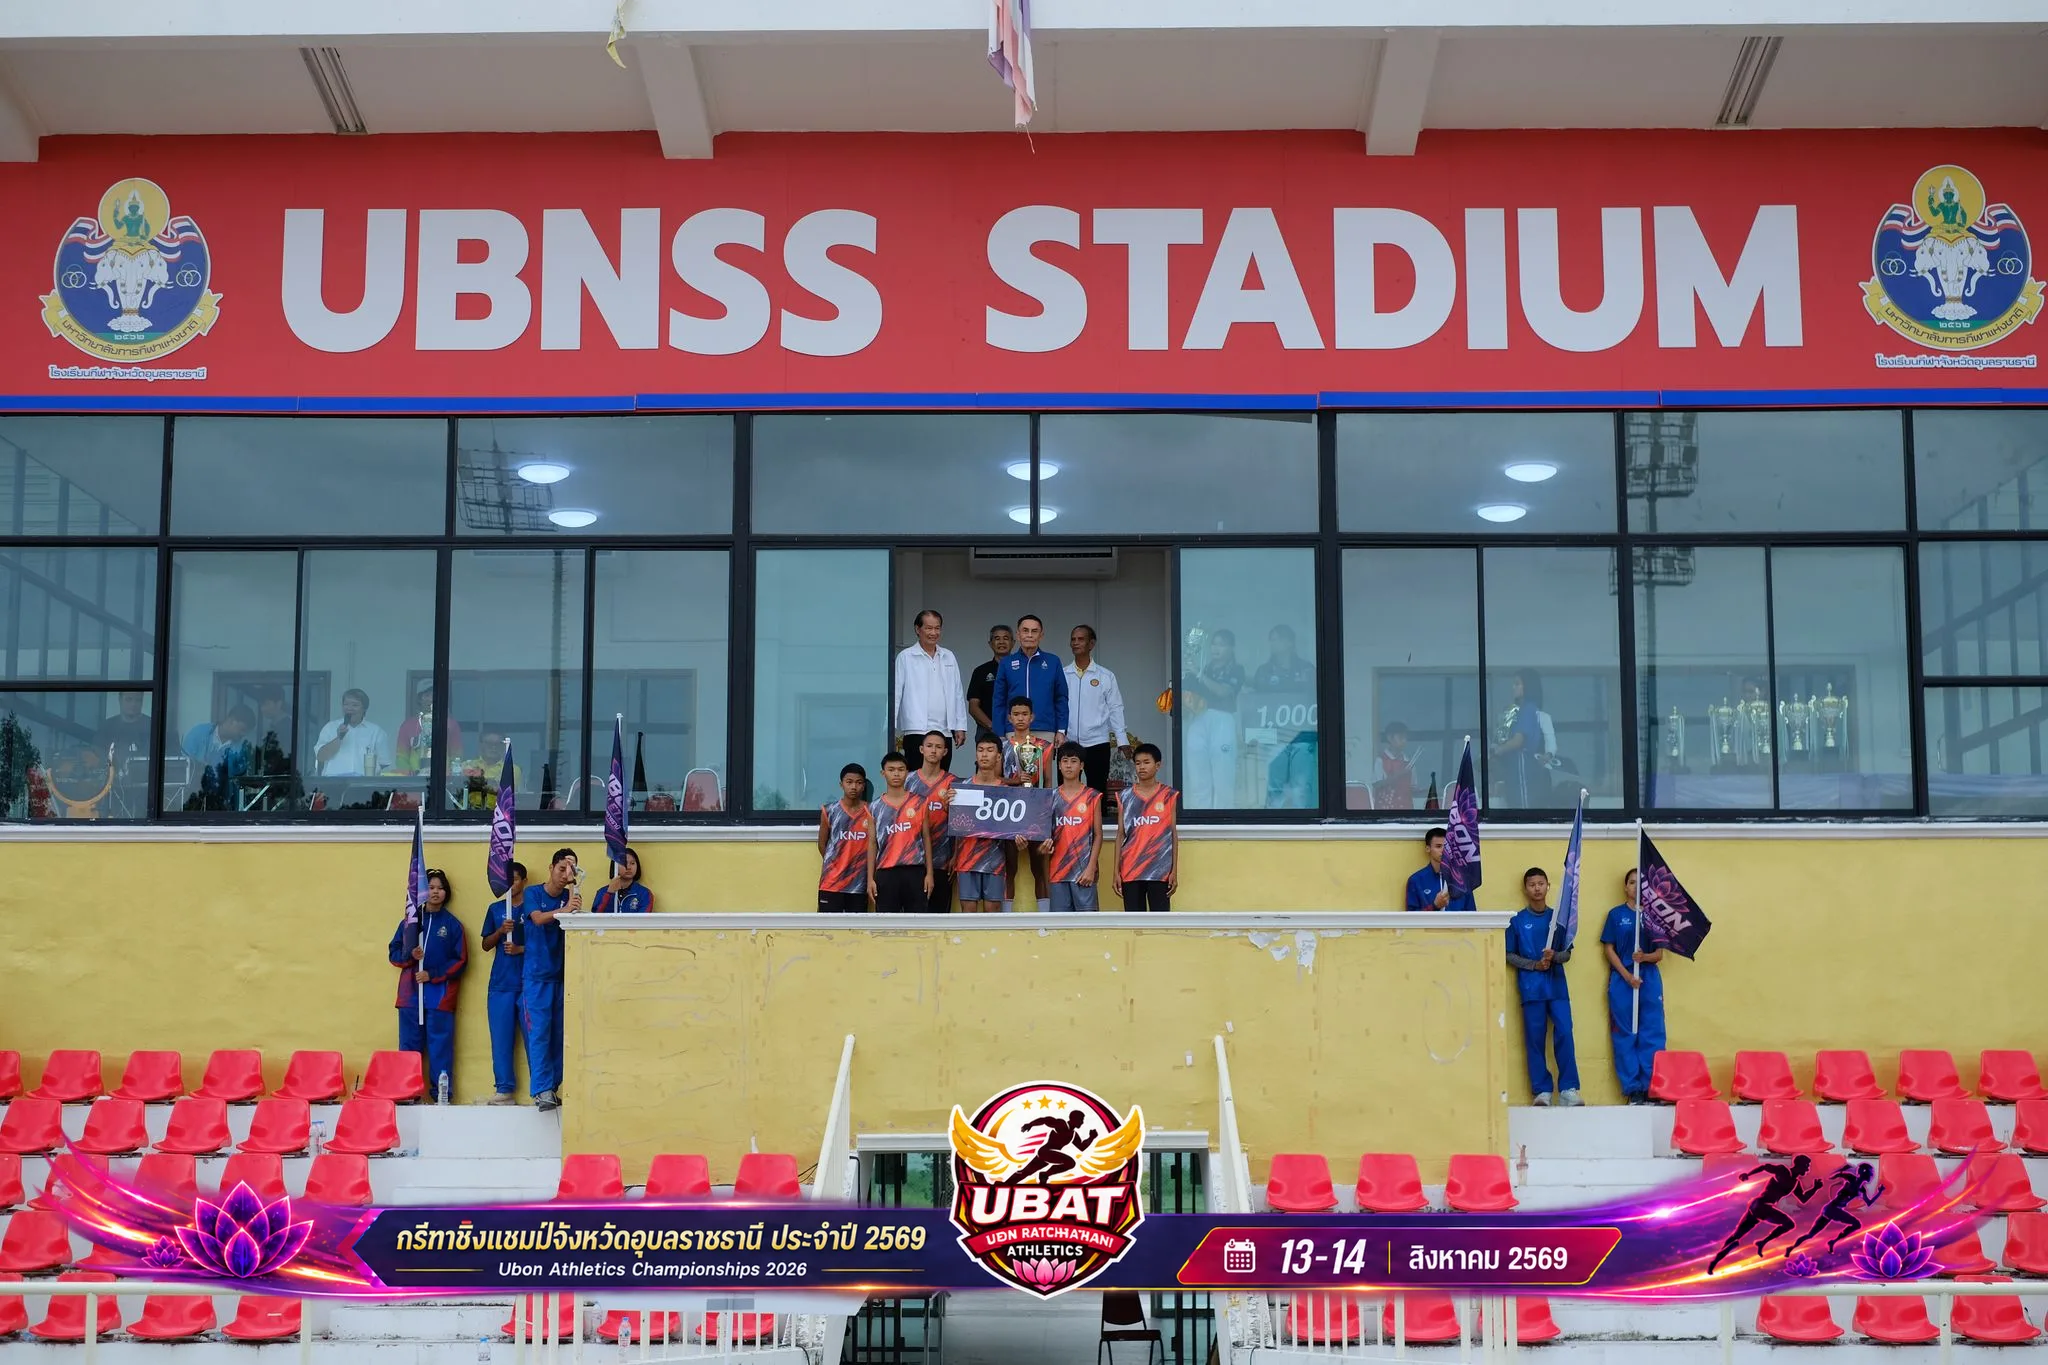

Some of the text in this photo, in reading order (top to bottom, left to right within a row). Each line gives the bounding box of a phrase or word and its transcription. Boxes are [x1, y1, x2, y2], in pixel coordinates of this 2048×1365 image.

[282, 204, 1804, 357] UBNSS STADIUM
[975, 797, 1027, 823] 800
[1055, 816, 1083, 827] KNP
[1133, 816, 1160, 827] KNP
[886, 821, 912, 835] KNP
[840, 830, 866, 840] KNP
